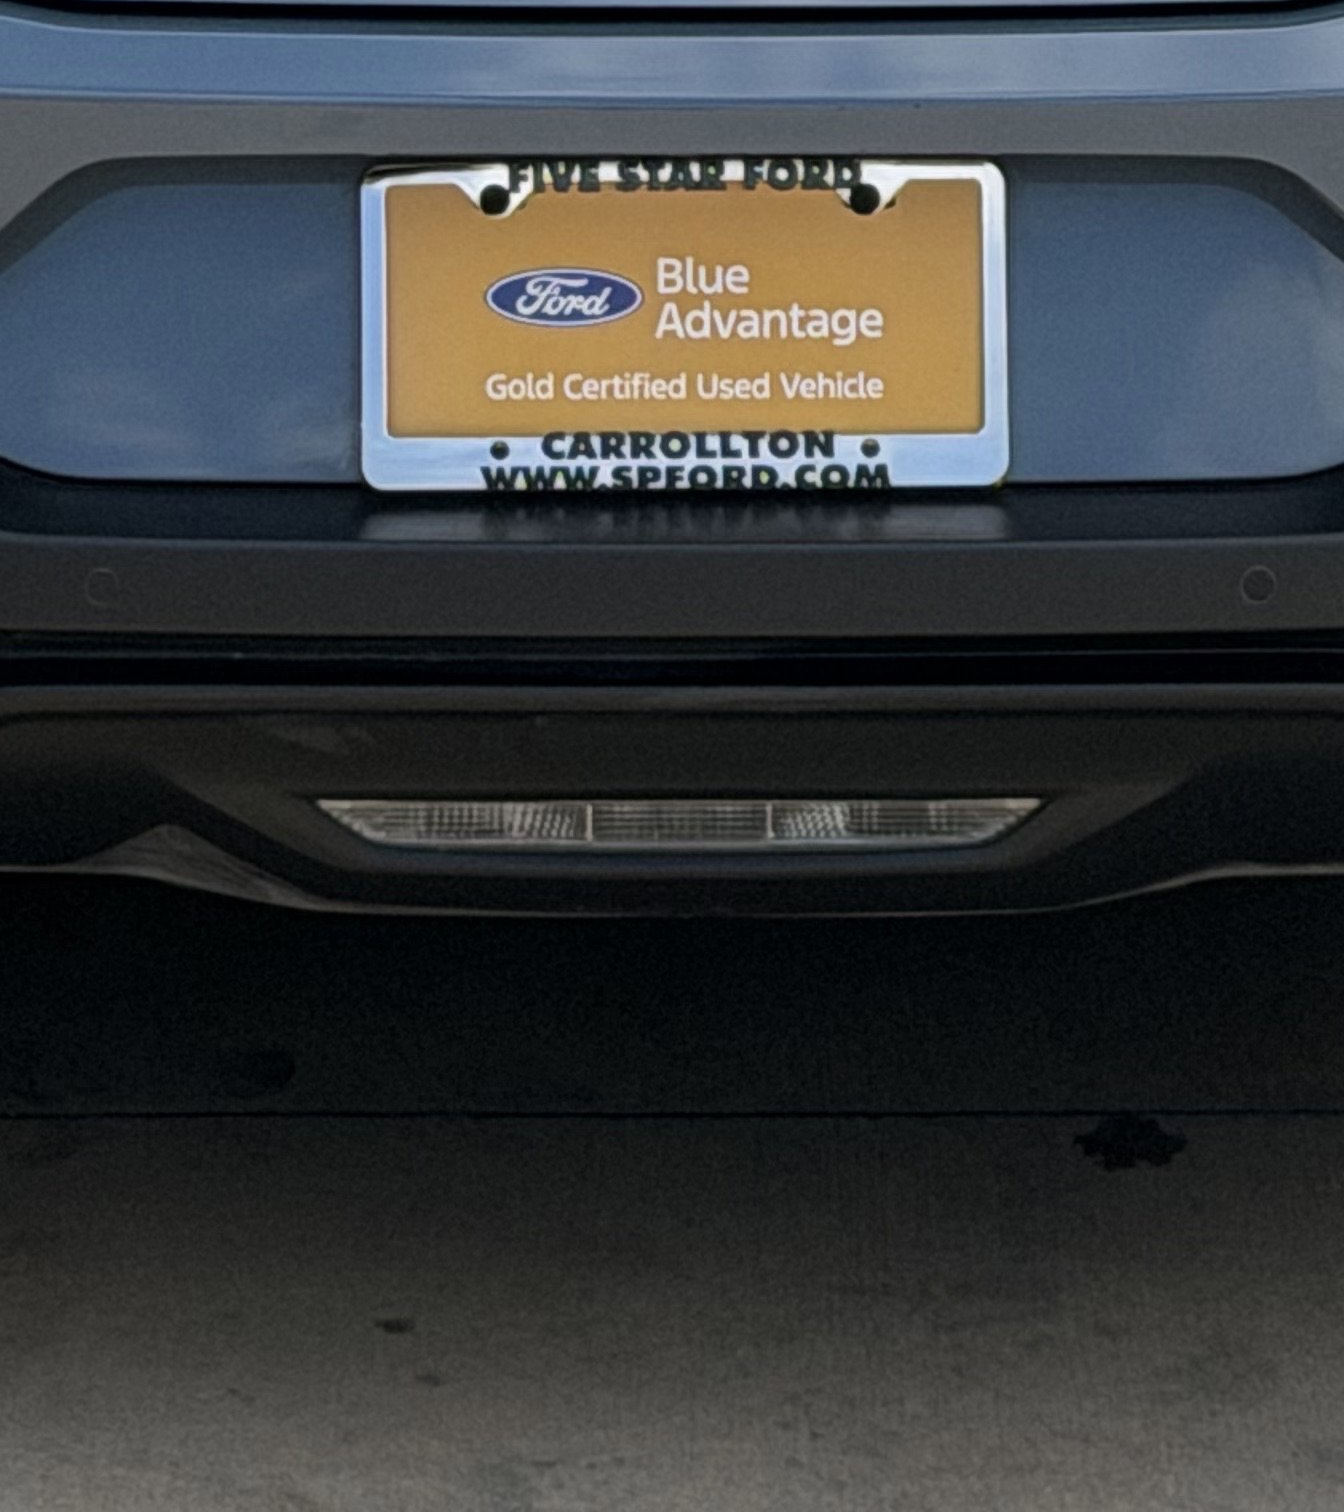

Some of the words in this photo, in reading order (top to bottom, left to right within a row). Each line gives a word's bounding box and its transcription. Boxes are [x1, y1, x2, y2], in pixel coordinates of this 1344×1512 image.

[507, 159, 601, 193] FIVE
[616, 159, 727, 192] STAR
[744, 159, 862, 191] FORD
[656, 256, 751, 295] Blue
[515, 274, 610, 316] Ford
[655, 300, 884, 346] Advantage
[485, 372, 554, 401] Gold
[563, 372, 687, 401] Certified
[697, 372, 771, 400] Used
[780, 371, 884, 400] Vehicle
[541, 430, 835, 460] CARROLLTON
[480, 463, 892, 490] WWW.SPFORD.COM
